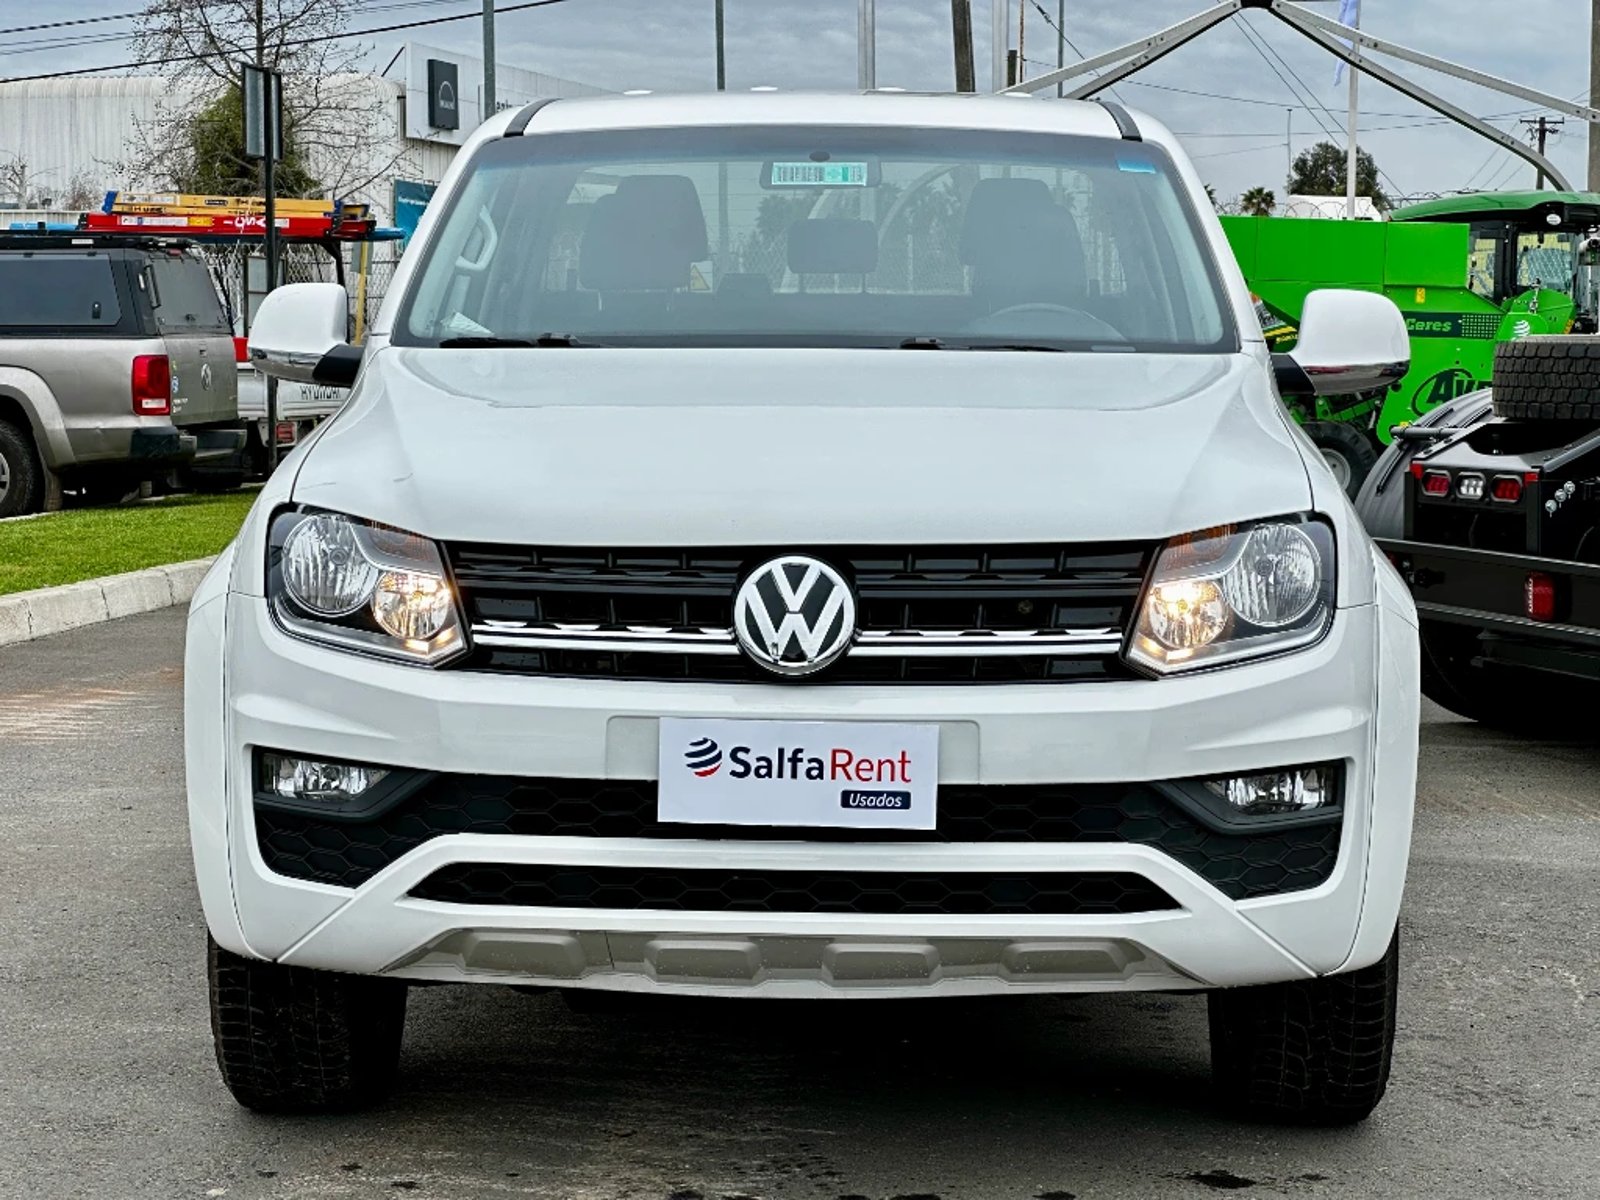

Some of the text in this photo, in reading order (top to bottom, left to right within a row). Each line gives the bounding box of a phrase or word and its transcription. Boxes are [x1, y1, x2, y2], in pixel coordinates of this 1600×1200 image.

[1405, 318, 1452, 332] Ceres
[729, 746, 912, 783] SalfaRent
[849, 792, 902, 807] Usados
